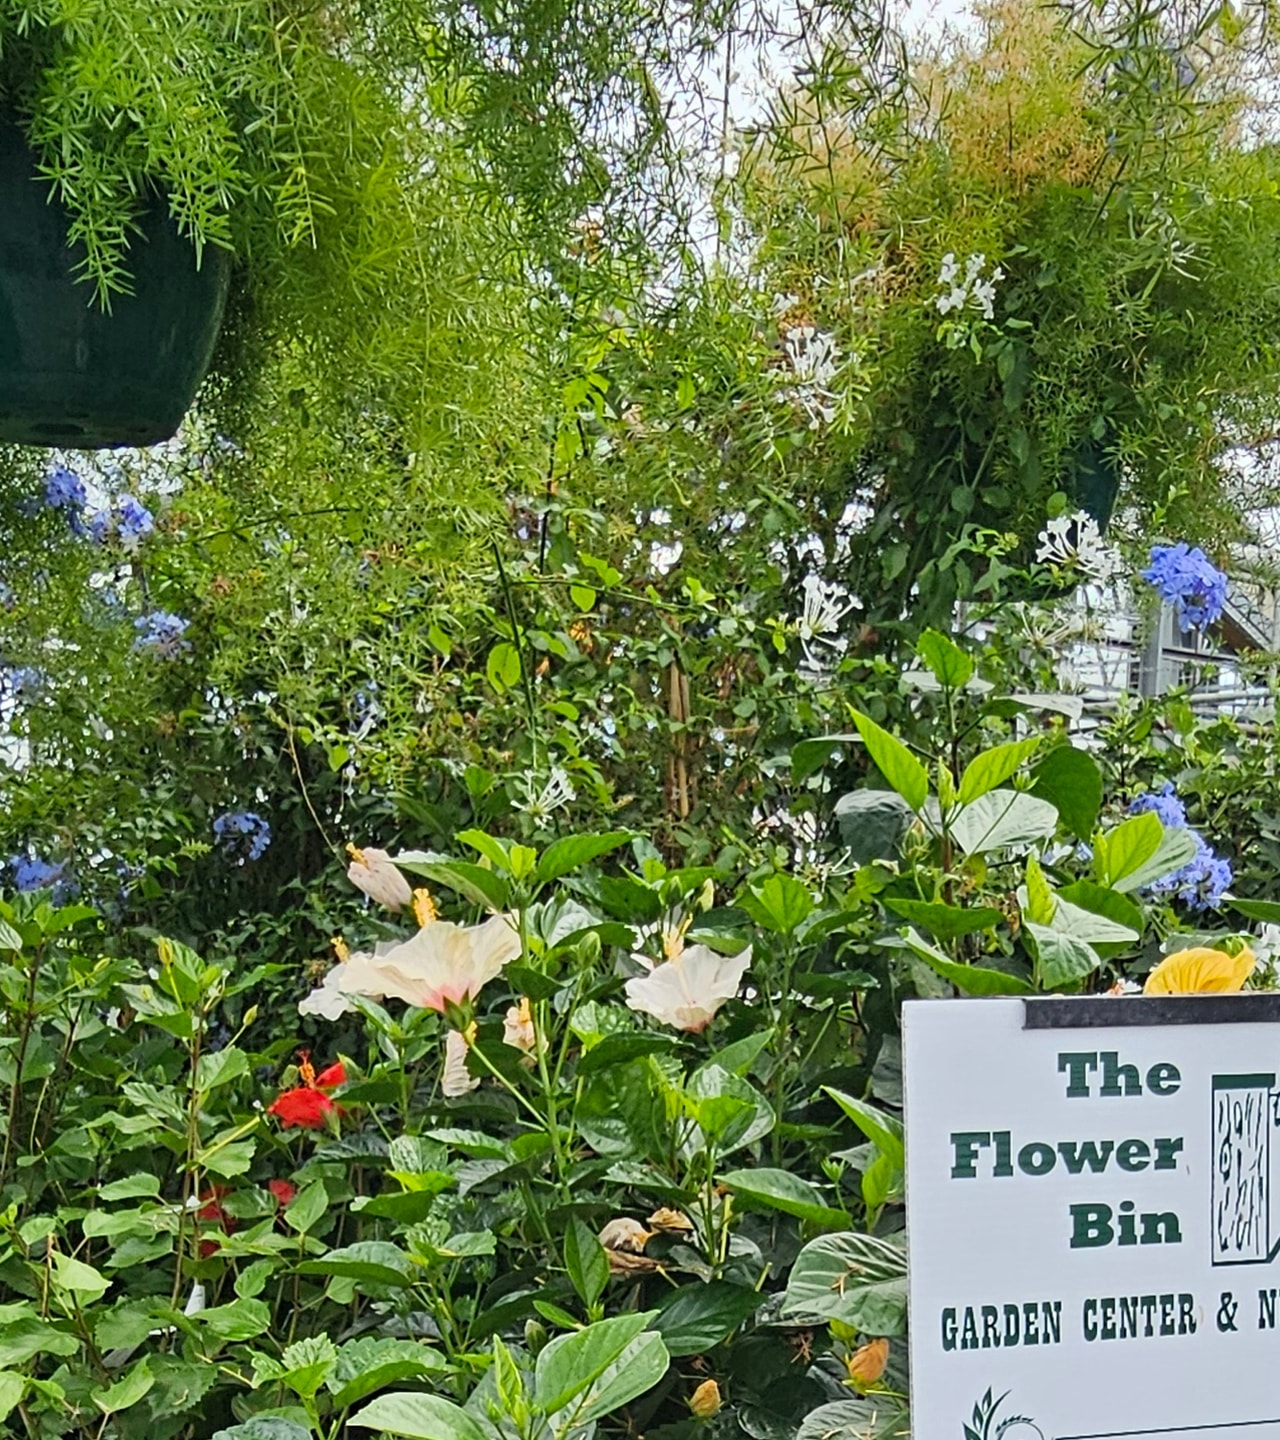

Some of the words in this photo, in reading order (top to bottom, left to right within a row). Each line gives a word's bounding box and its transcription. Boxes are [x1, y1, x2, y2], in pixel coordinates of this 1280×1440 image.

[1057, 1051, 1182, 1099] The
[949, 1130, 1184, 1180] Flower
[1068, 1200, 1183, 1250] Bin
[941, 1299, 1063, 1353] GARDEN
[1082, 1291, 1198, 1344] CENTER
[1216, 1290, 1239, 1333] &
